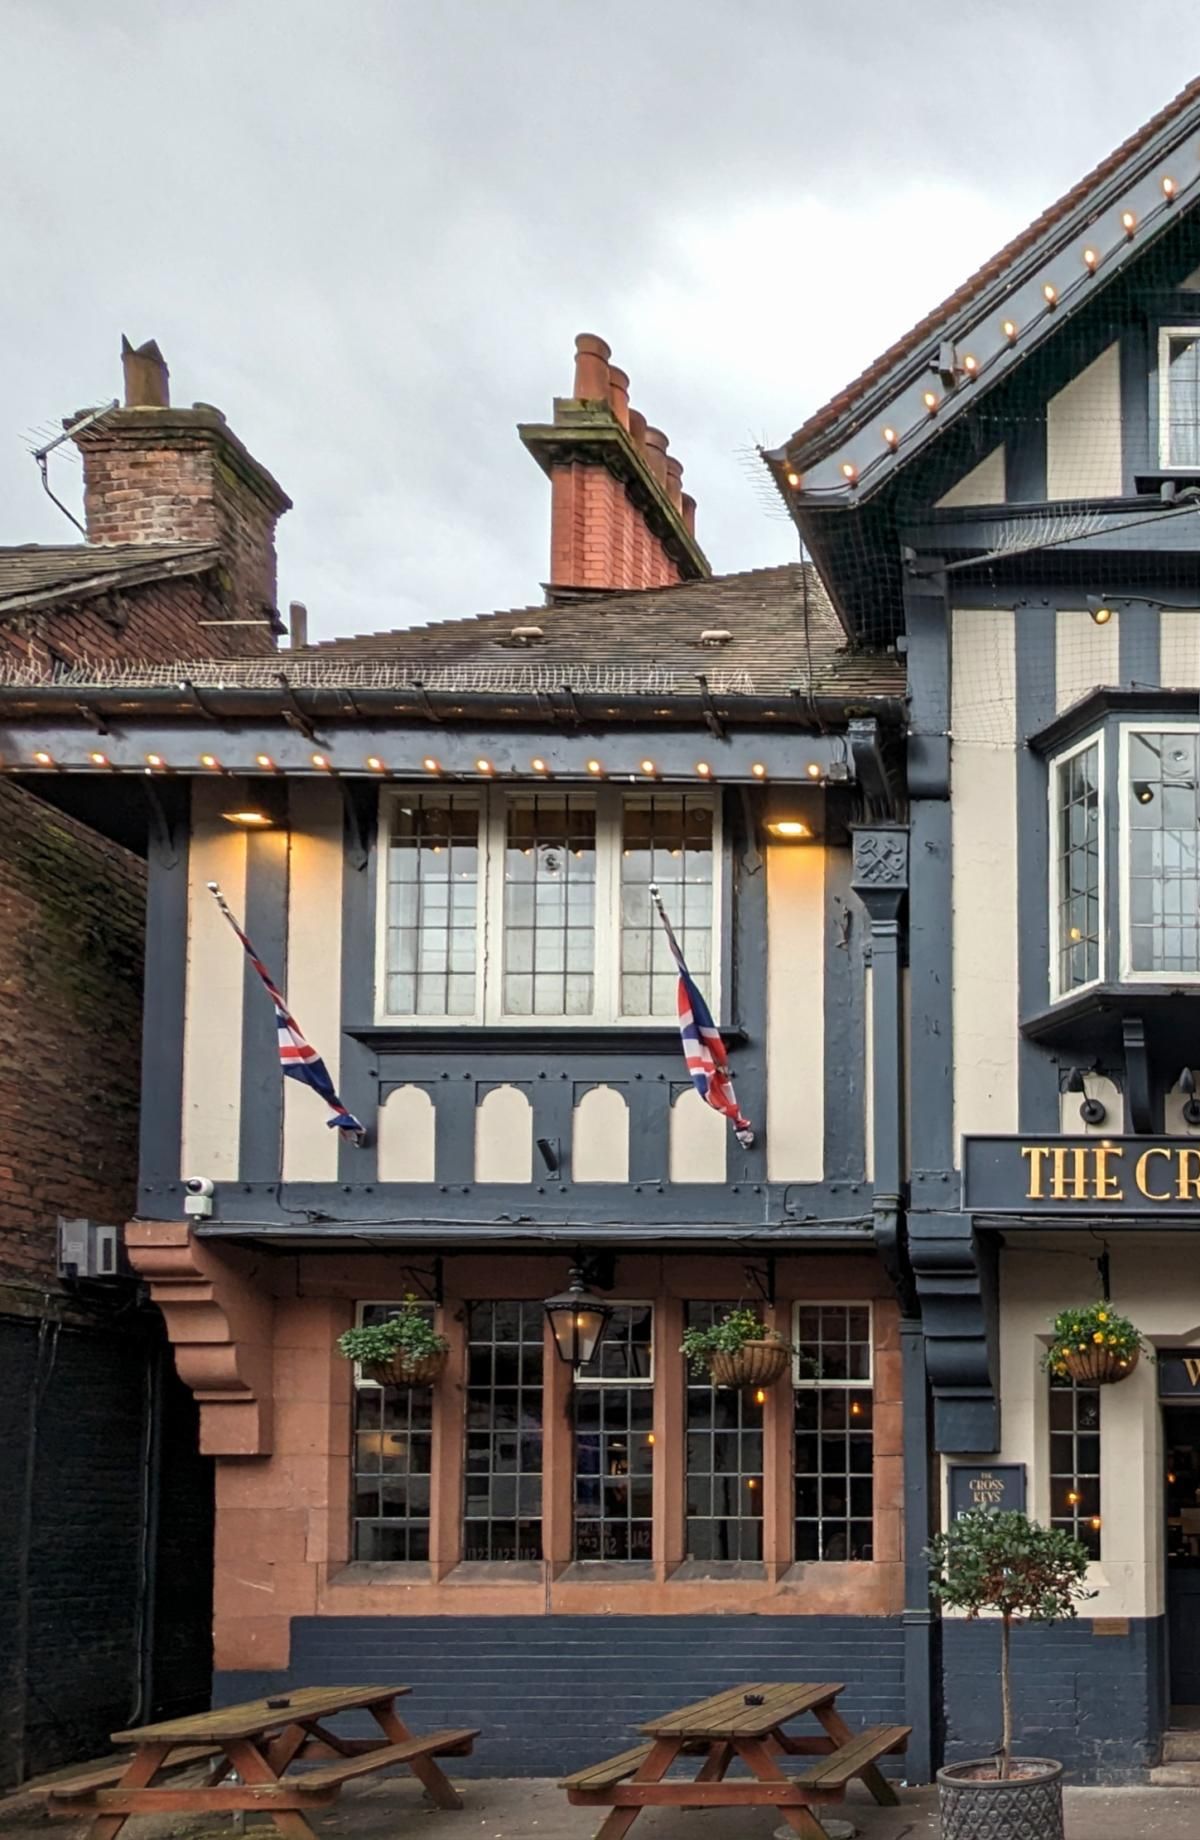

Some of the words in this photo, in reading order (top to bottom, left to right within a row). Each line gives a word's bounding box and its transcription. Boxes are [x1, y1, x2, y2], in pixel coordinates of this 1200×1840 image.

[1021, 1147, 1123, 1200] THE
[969, 1479, 1005, 1490] CROSS
[974, 1491, 1001, 1503] KEYS
